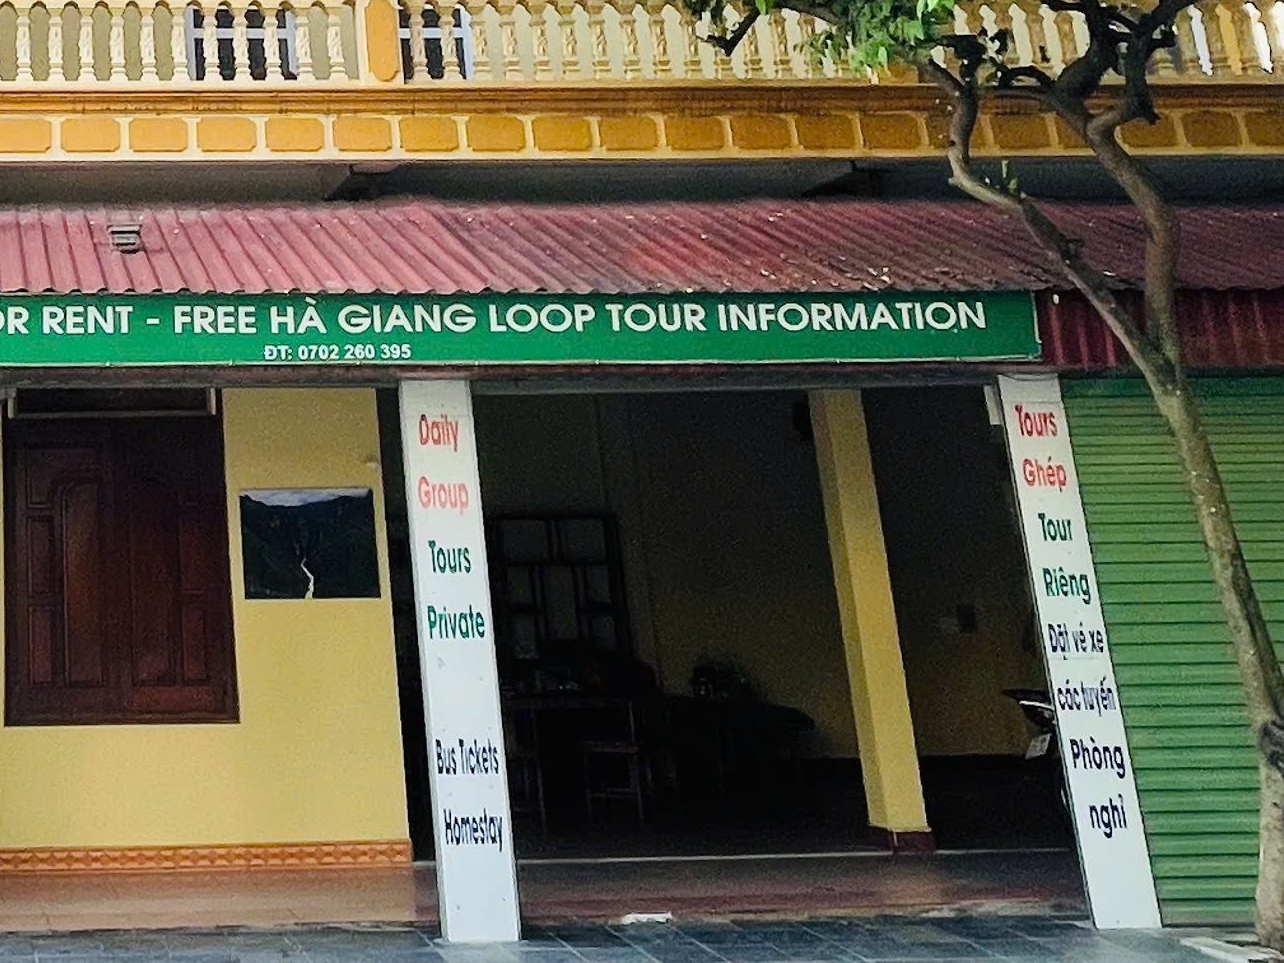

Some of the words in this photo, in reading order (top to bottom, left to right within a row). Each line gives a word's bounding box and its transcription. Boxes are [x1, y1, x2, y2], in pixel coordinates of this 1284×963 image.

[42, 305, 133, 335] RENT
[174, 304, 257, 334] FREE
[270, 297, 327, 334] HÀ
[338, 303, 476, 334] GIANG
[490, 303, 596, 333] LOOP
[605, 302, 707, 333] TOUR
[718, 301, 987, 332] INFORMATION
[264, 345, 293, 360] ĐT:
[298, 344, 340, 360] 0702
[344, 344, 376, 359] 260
[380, 343, 412, 359] 395
[419, 413, 460, 452] Daily
[1015, 404, 1058, 437] Tours
[1022, 456, 1067, 492] Ghép
[418, 476, 469, 515] Group
[1037, 513, 1073, 542] Tour
[428, 540, 472, 574] Tours
[1042, 567, 1092, 605] Riêng
[427, 604, 486, 639] Private
[1089, 629, 1104, 653] xe
[1056, 679, 1081, 711] các
[435, 739, 457, 775] Bus
[458, 738, 499, 775] Tickets
[1069, 736, 1127, 779] Phòng
[443, 808, 503, 852] Homestay
